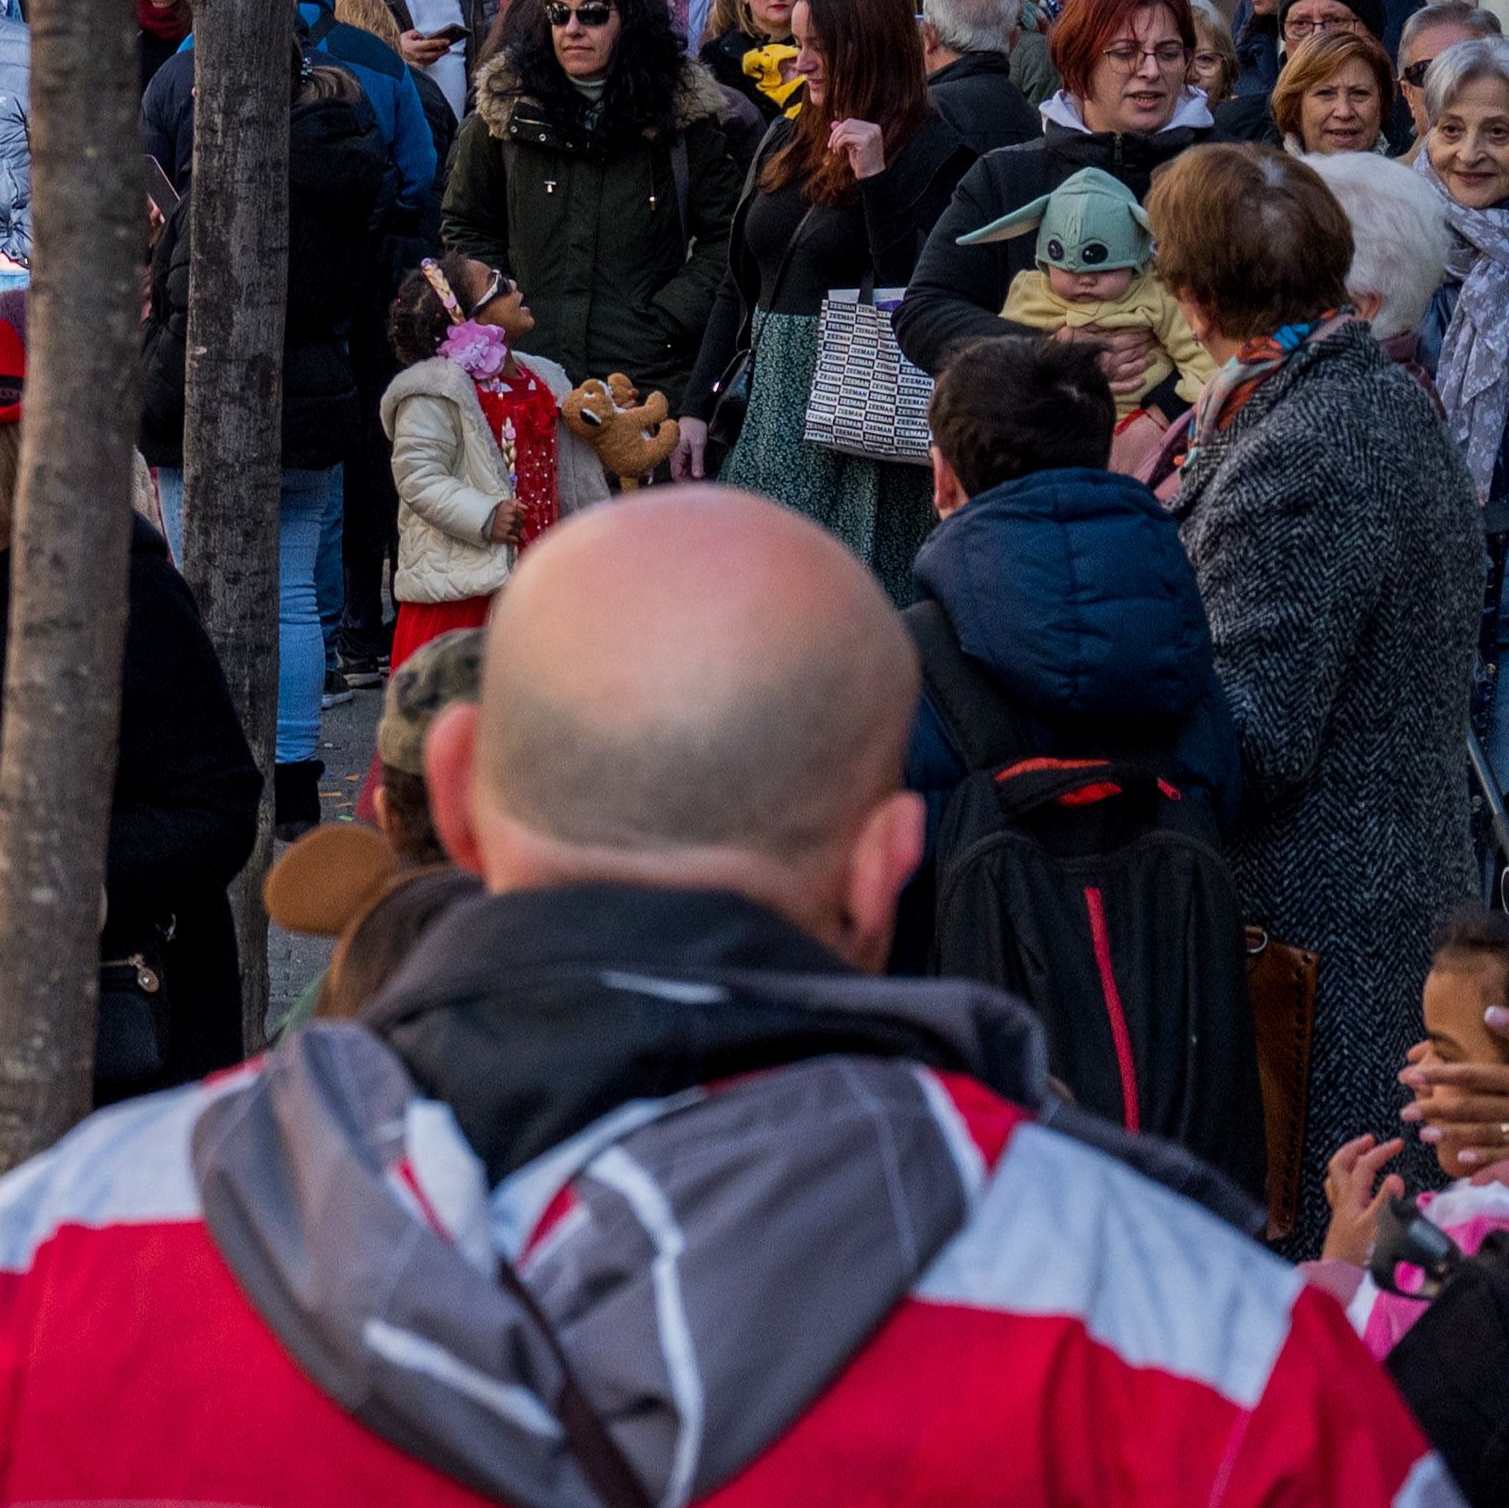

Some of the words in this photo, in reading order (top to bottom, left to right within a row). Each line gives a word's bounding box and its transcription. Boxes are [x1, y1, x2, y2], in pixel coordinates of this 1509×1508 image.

[900, 377, 932, 387] ZEEMAN
[899, 388, 931, 397] ZEEMAN
[896, 418, 928, 427] ZEEMAN
[896, 428, 928, 438] ZEEMAN
[896, 439, 927, 448] ZEEMAN
